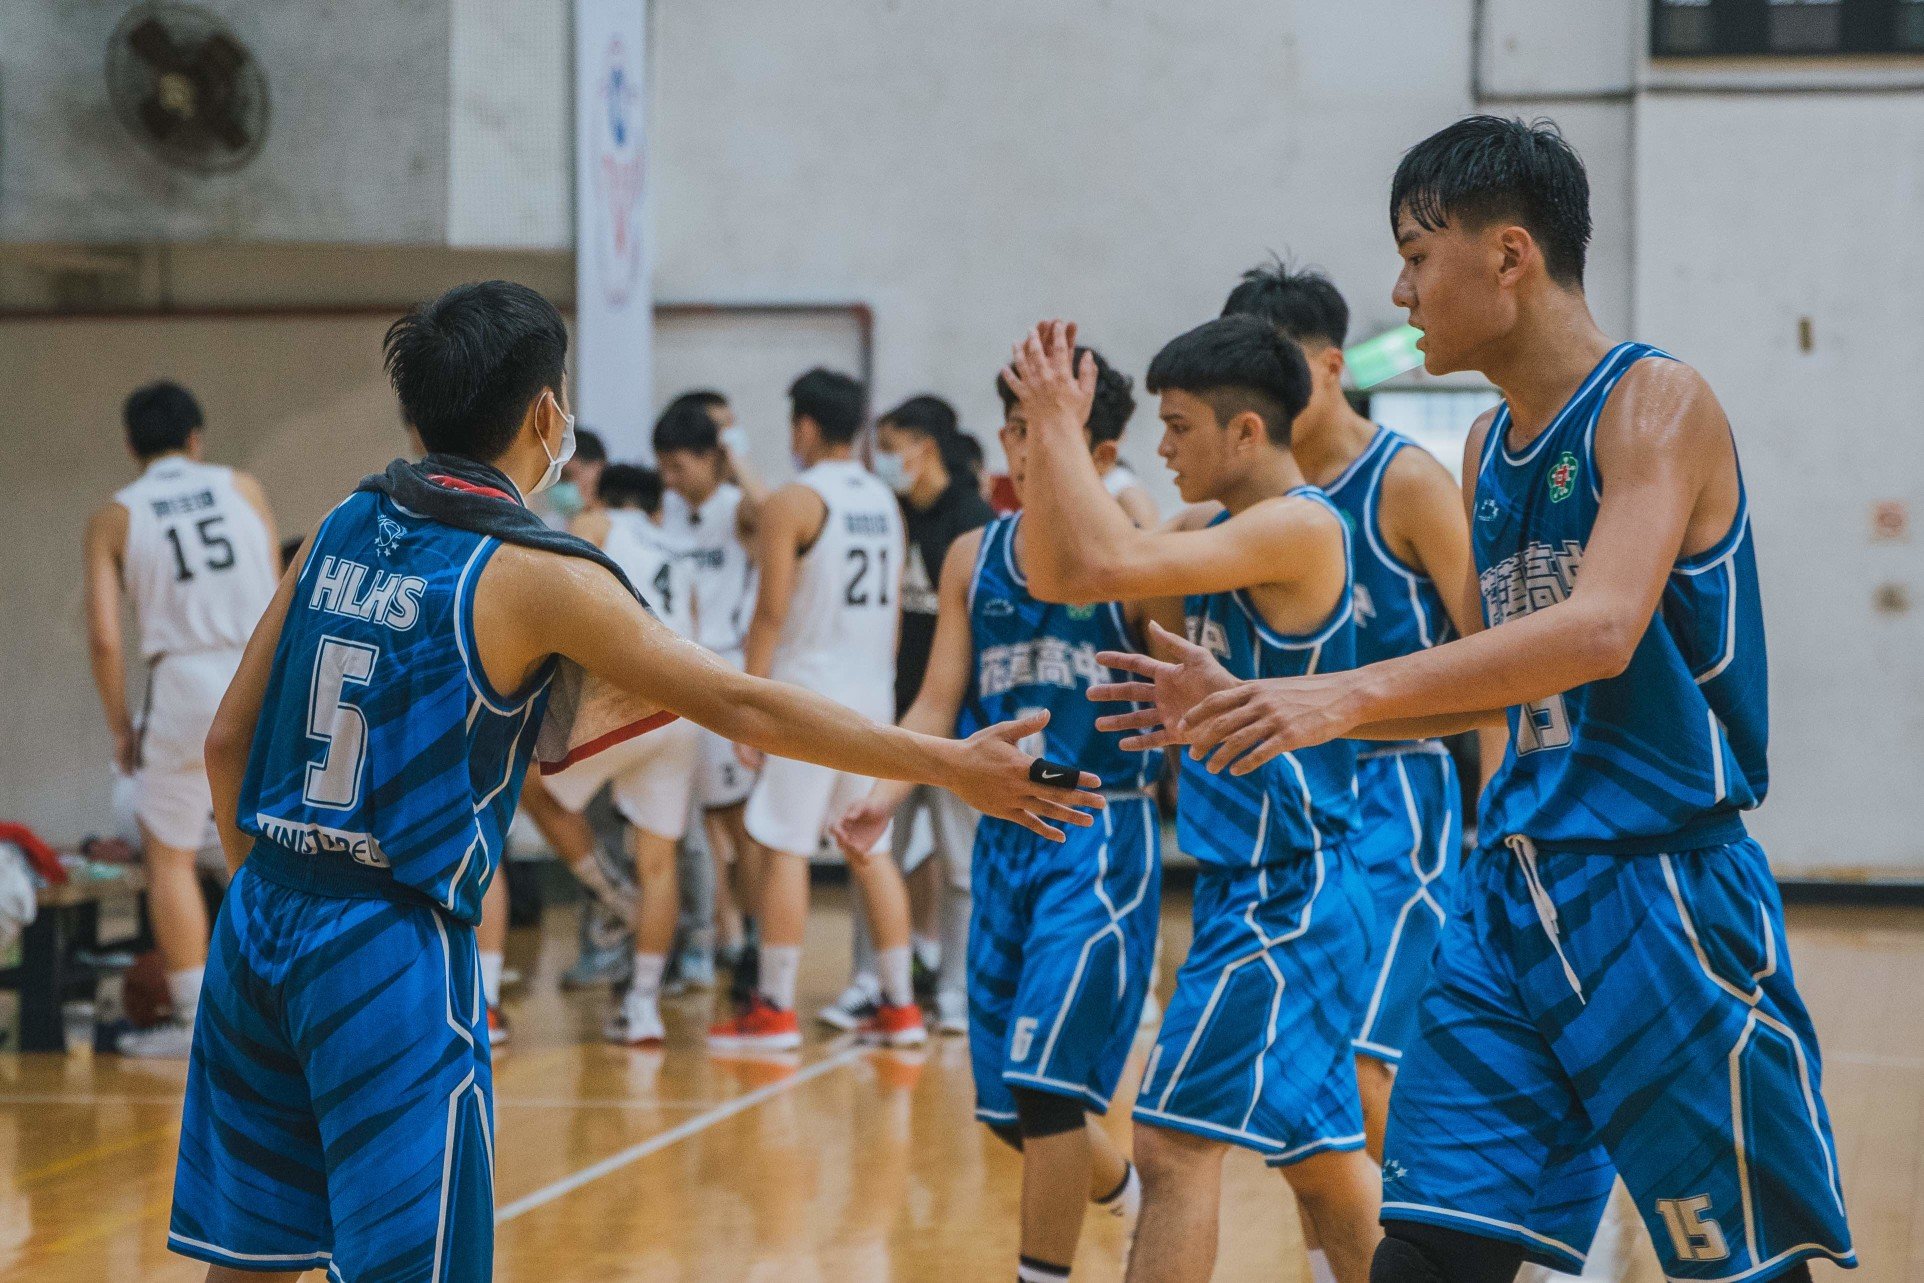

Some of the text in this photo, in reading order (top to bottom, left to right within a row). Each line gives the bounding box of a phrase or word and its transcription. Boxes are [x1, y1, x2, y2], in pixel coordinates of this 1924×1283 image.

[165, 513, 235, 582] 15
[845, 548, 889, 606] 21
[309, 555, 428, 632] HLHS
[302, 634, 380, 812] 5
[1010, 1016, 1038, 1062] 6
[1655, 1193, 1731, 1261] 15
